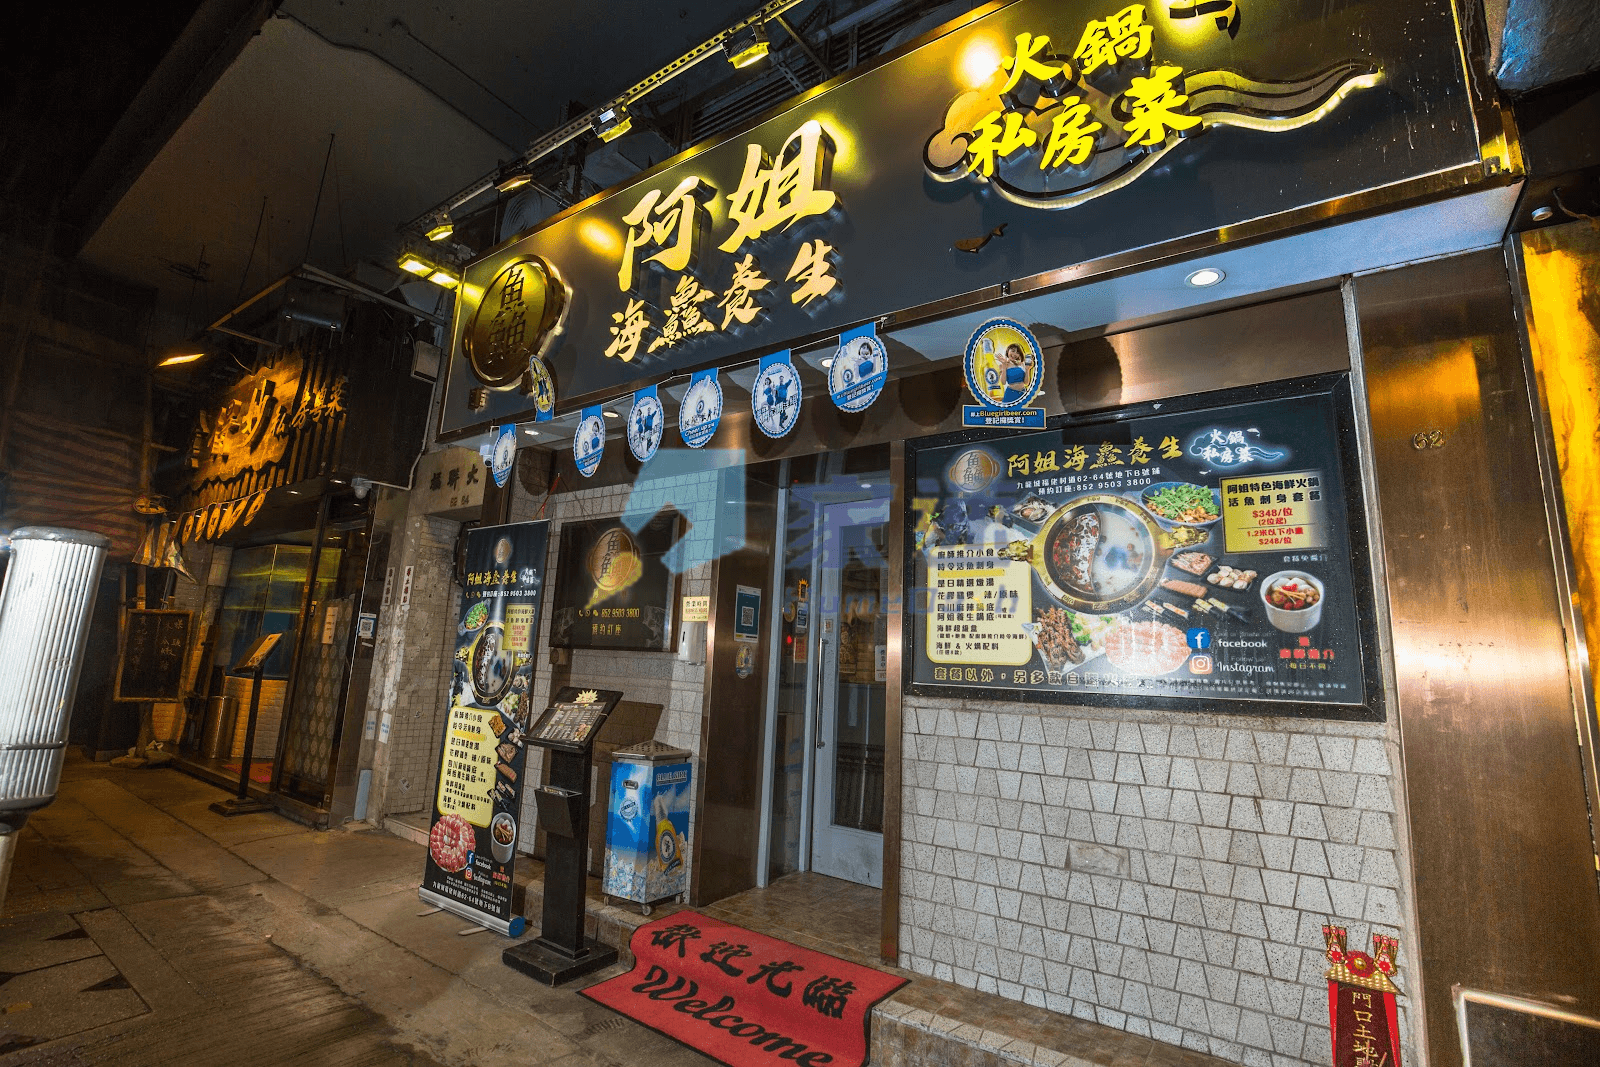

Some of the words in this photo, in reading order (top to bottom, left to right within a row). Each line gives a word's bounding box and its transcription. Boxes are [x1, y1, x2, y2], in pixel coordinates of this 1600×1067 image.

[1001, 4, 1154, 97] 火鍋
[967, 67, 1203, 177] 私房菜
[619, 120, 837, 292] 阿姐
[604, 239, 837, 361] 海鱻養生
[1210, 429, 1245, 444] 火鍋
[1413, 429, 1445, 449] 62
[1007, 435, 1184, 478] 阿姐海鱻養生
[1203, 445, 1255, 464] 私房菜
[1098, 480, 1122, 489] 9503
[1126, 478, 1151, 486] 3800
[1227, 477, 1320, 494] 阿姐特色海鮮火鍋
[1228, 490, 1321, 507] 活魚刺身套餐
[1252, 507, 1293, 518] $348/位
[1258, 517, 1287, 526] (2位起)
[1259, 536, 1292, 545] $248/位
[938, 548, 994, 559] 廚師推介小食
[938, 561, 994, 570] 時令活魚刺身
[626, 608, 640, 617] 3800
[937, 603, 995, 612] 四川麻辣鍋底
[937, 612, 995, 621] 阿姐養生鍋底
[592, 624, 622, 635] 預約訂座
[936, 642, 951, 650] 海鮮
[1218, 639, 1267, 648] facebook
[1217, 661, 1275, 676] Instagram
[475, 859, 492, 870] facebook
[631, 965, 834, 1066] Welcome
